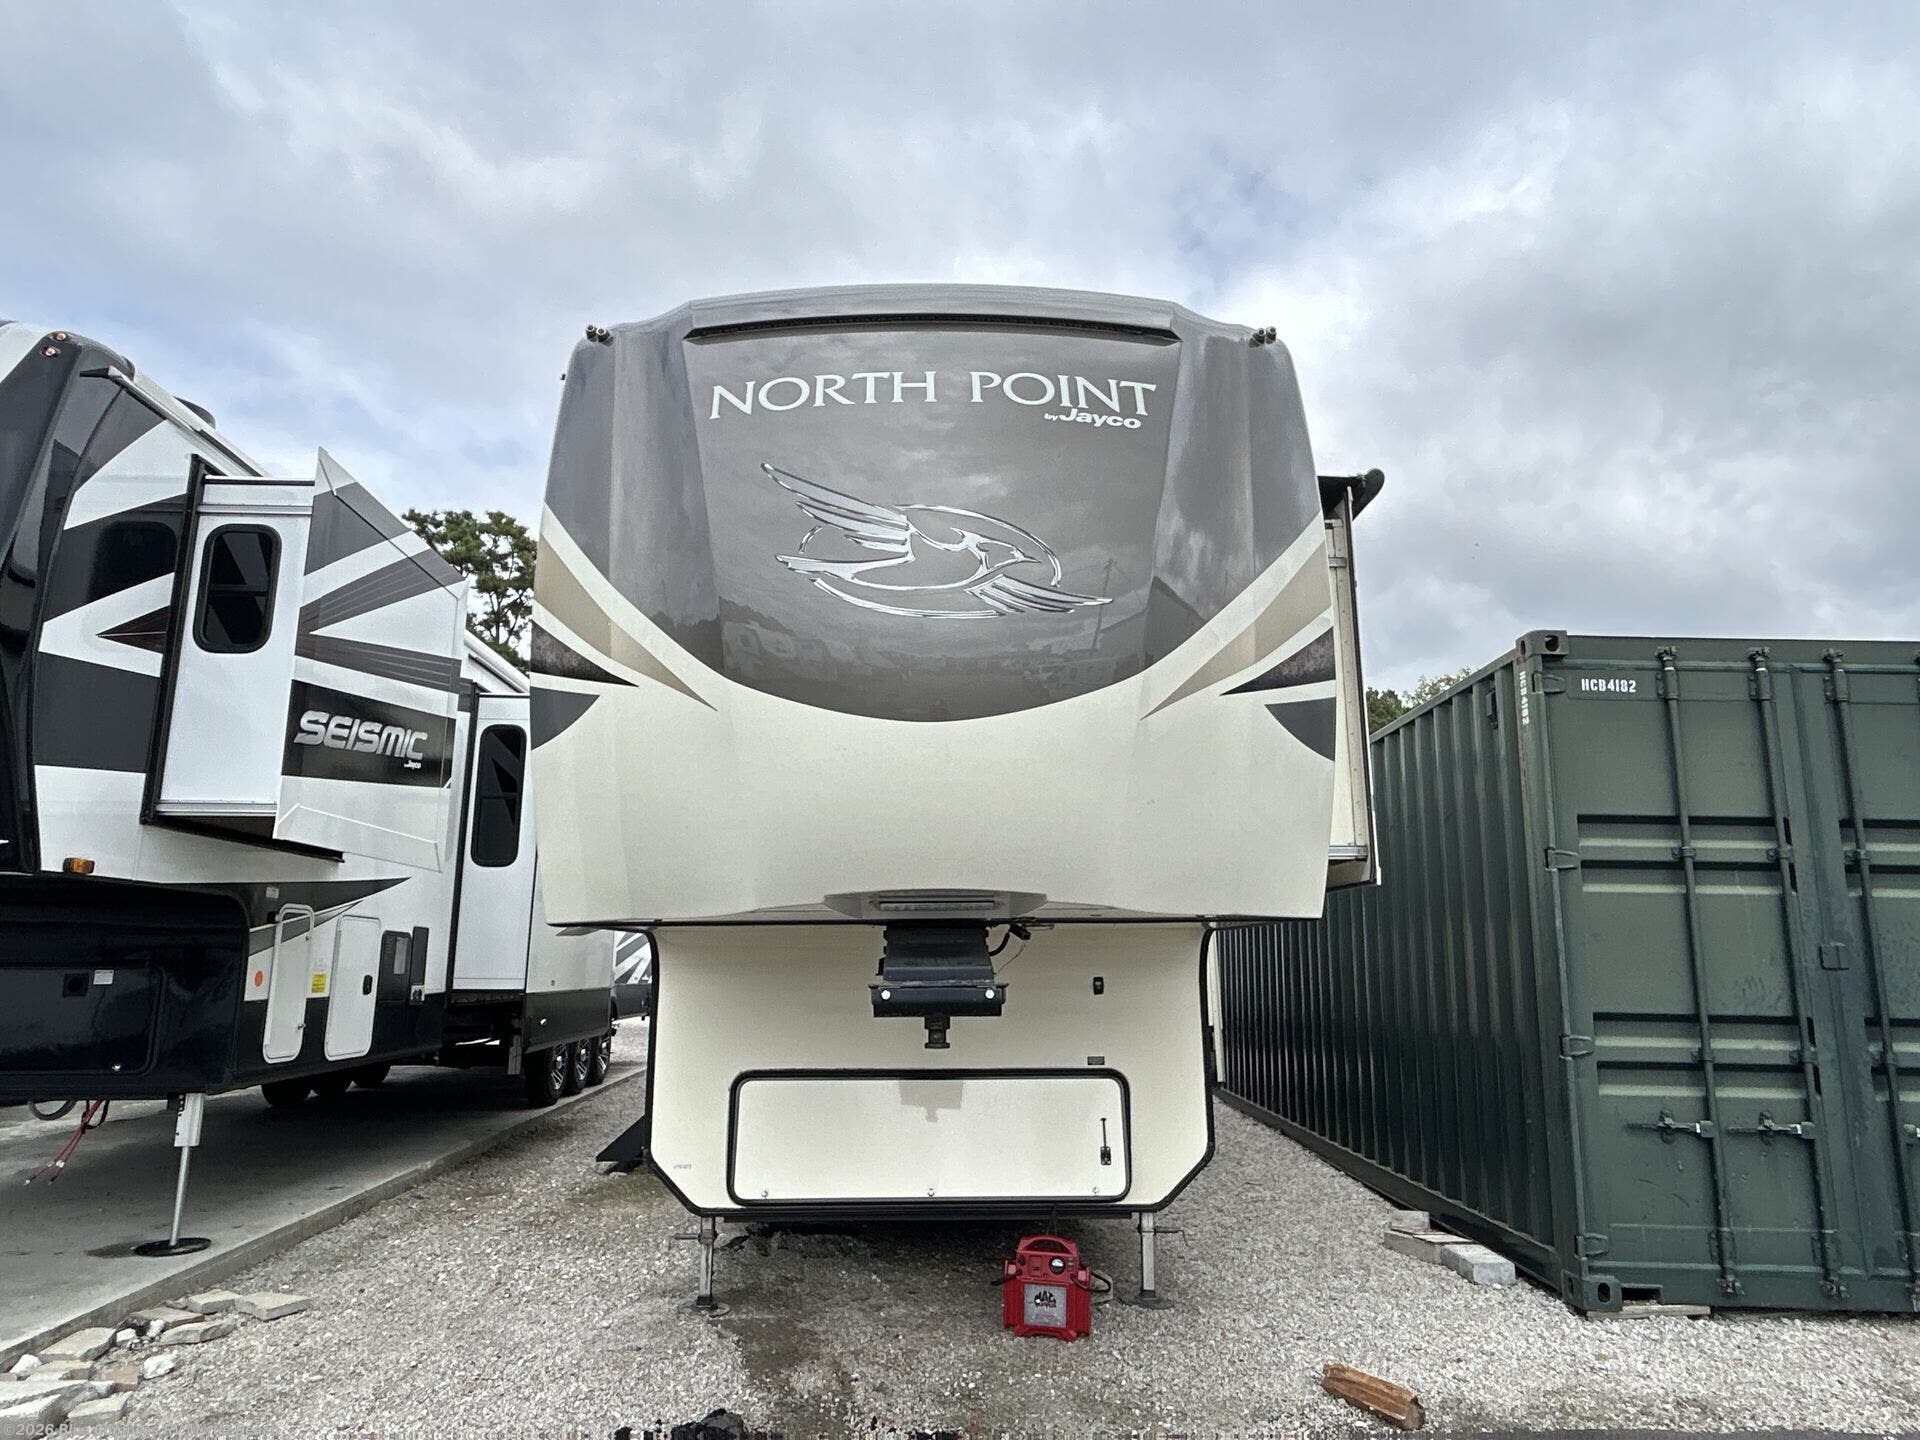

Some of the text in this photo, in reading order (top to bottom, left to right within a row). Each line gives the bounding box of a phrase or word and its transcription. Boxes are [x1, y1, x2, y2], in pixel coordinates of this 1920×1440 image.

[709, 371, 1157, 420] NORTH POINT
[1044, 408, 1142, 429] by Jayco
[293, 709, 428, 761] SEISMIC
